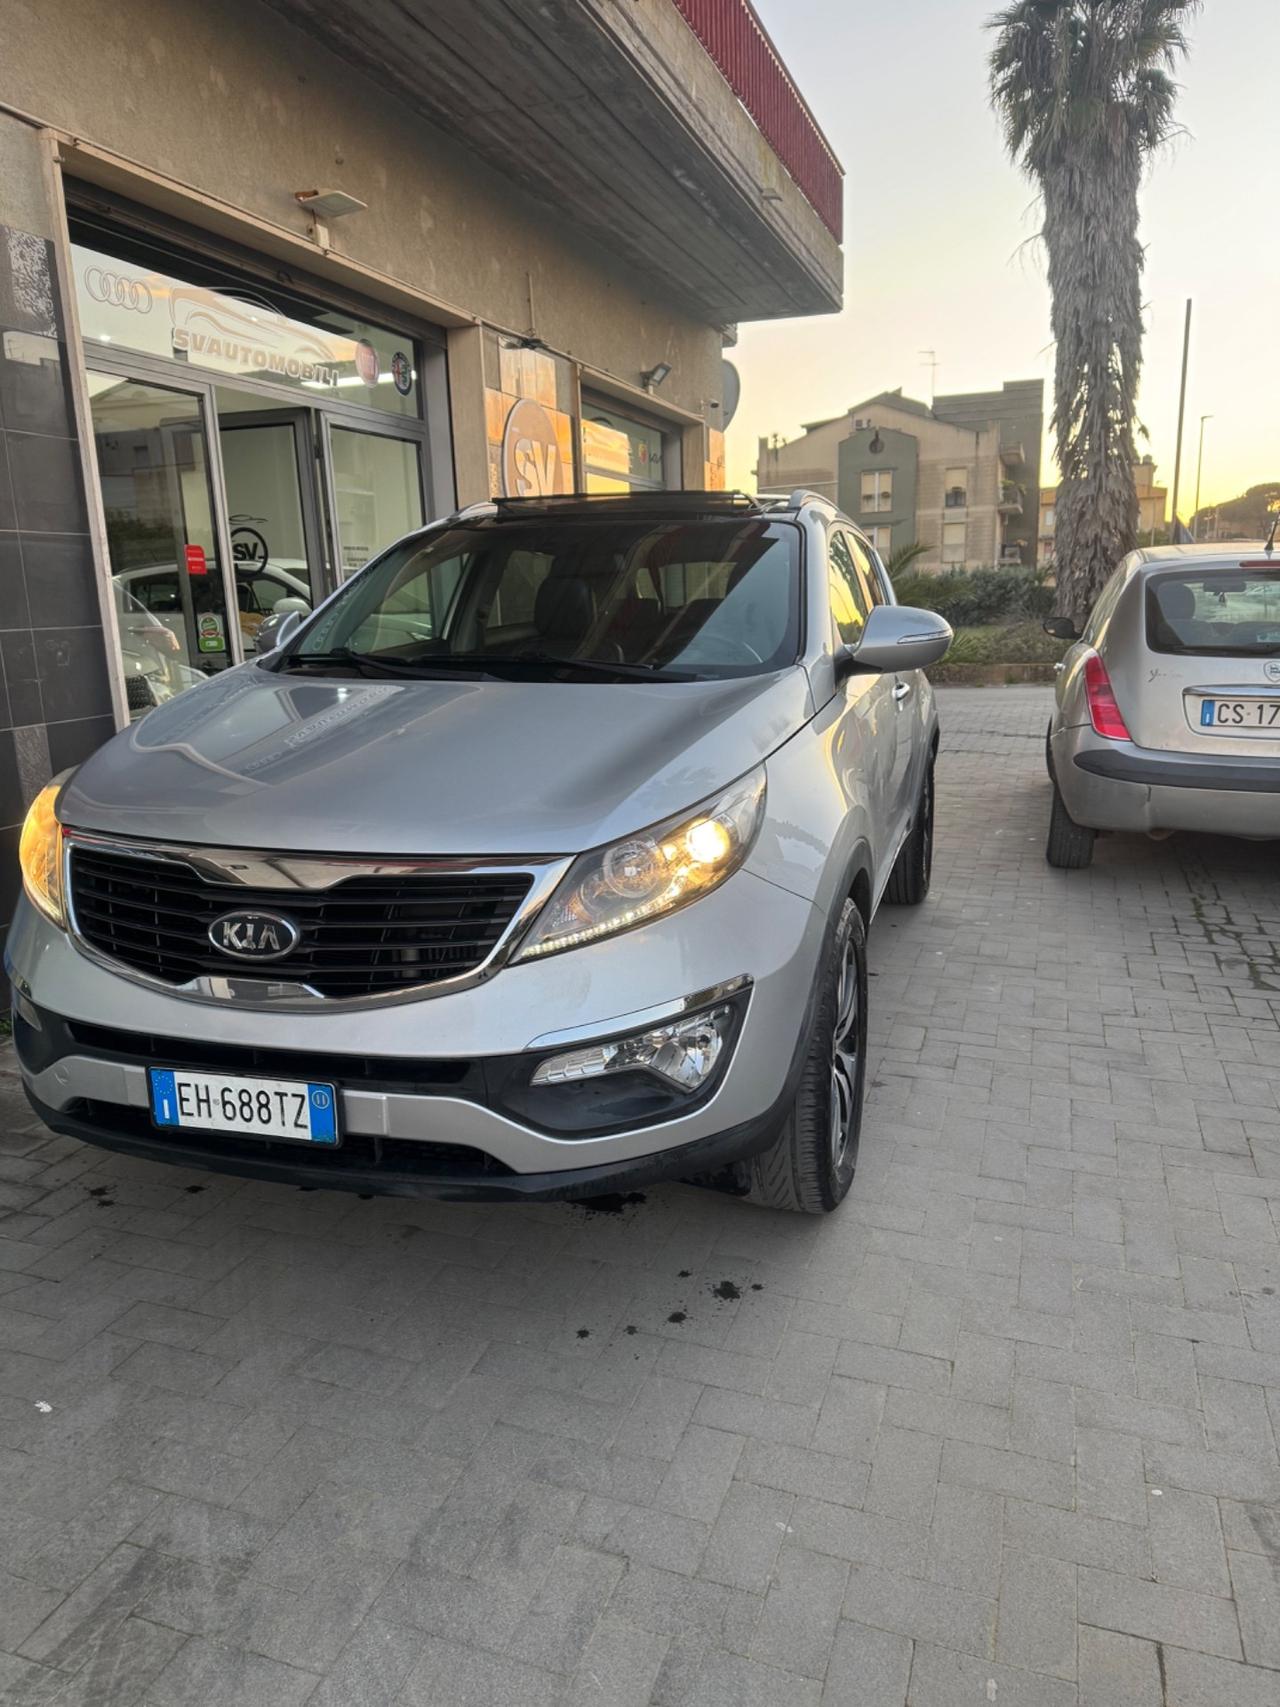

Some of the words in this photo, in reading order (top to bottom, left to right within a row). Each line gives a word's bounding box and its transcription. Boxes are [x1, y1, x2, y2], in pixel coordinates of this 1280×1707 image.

[514, 438, 556, 496] SV
[232, 542, 259, 561] SV
[1217, 703, 1245, 725] CS
[1256, 703, 1280, 726] 17
[221, 921, 281, 951] KIA
[176, 1082, 213, 1119] EH
[220, 1086, 309, 1130] 688TZ
